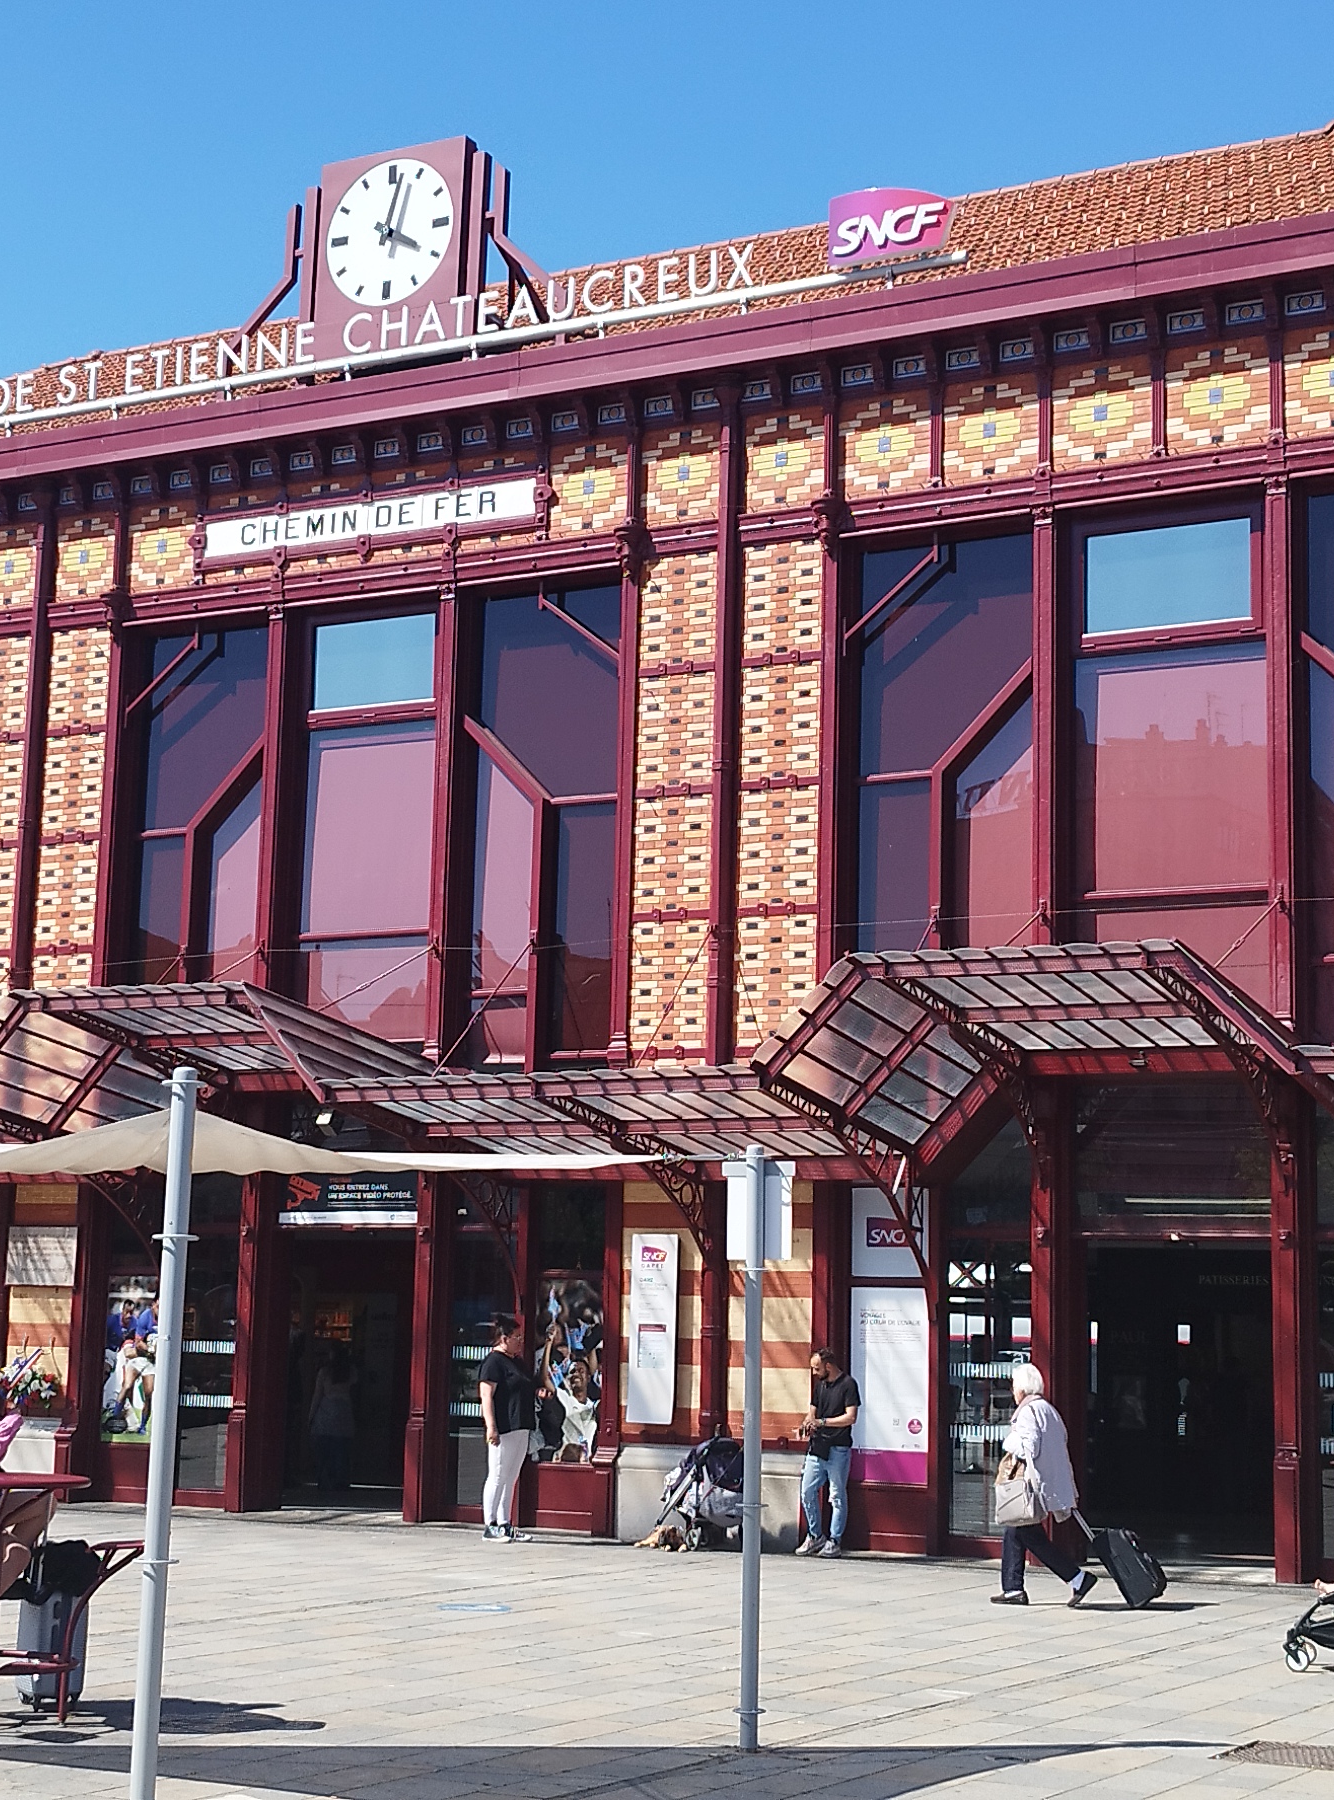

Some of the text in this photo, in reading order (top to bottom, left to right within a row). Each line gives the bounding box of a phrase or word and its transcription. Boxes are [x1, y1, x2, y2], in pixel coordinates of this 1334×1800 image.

[832, 201, 945, 255] SNCF
[55, 360, 104, 405] ST
[124, 321, 316, 395] ETIENNE
[342, 242, 755, 354] CHATEAUCREUX
[241, 489, 497, 546] CHEMIN DE FER
[868, 1228, 907, 1244] SNC
